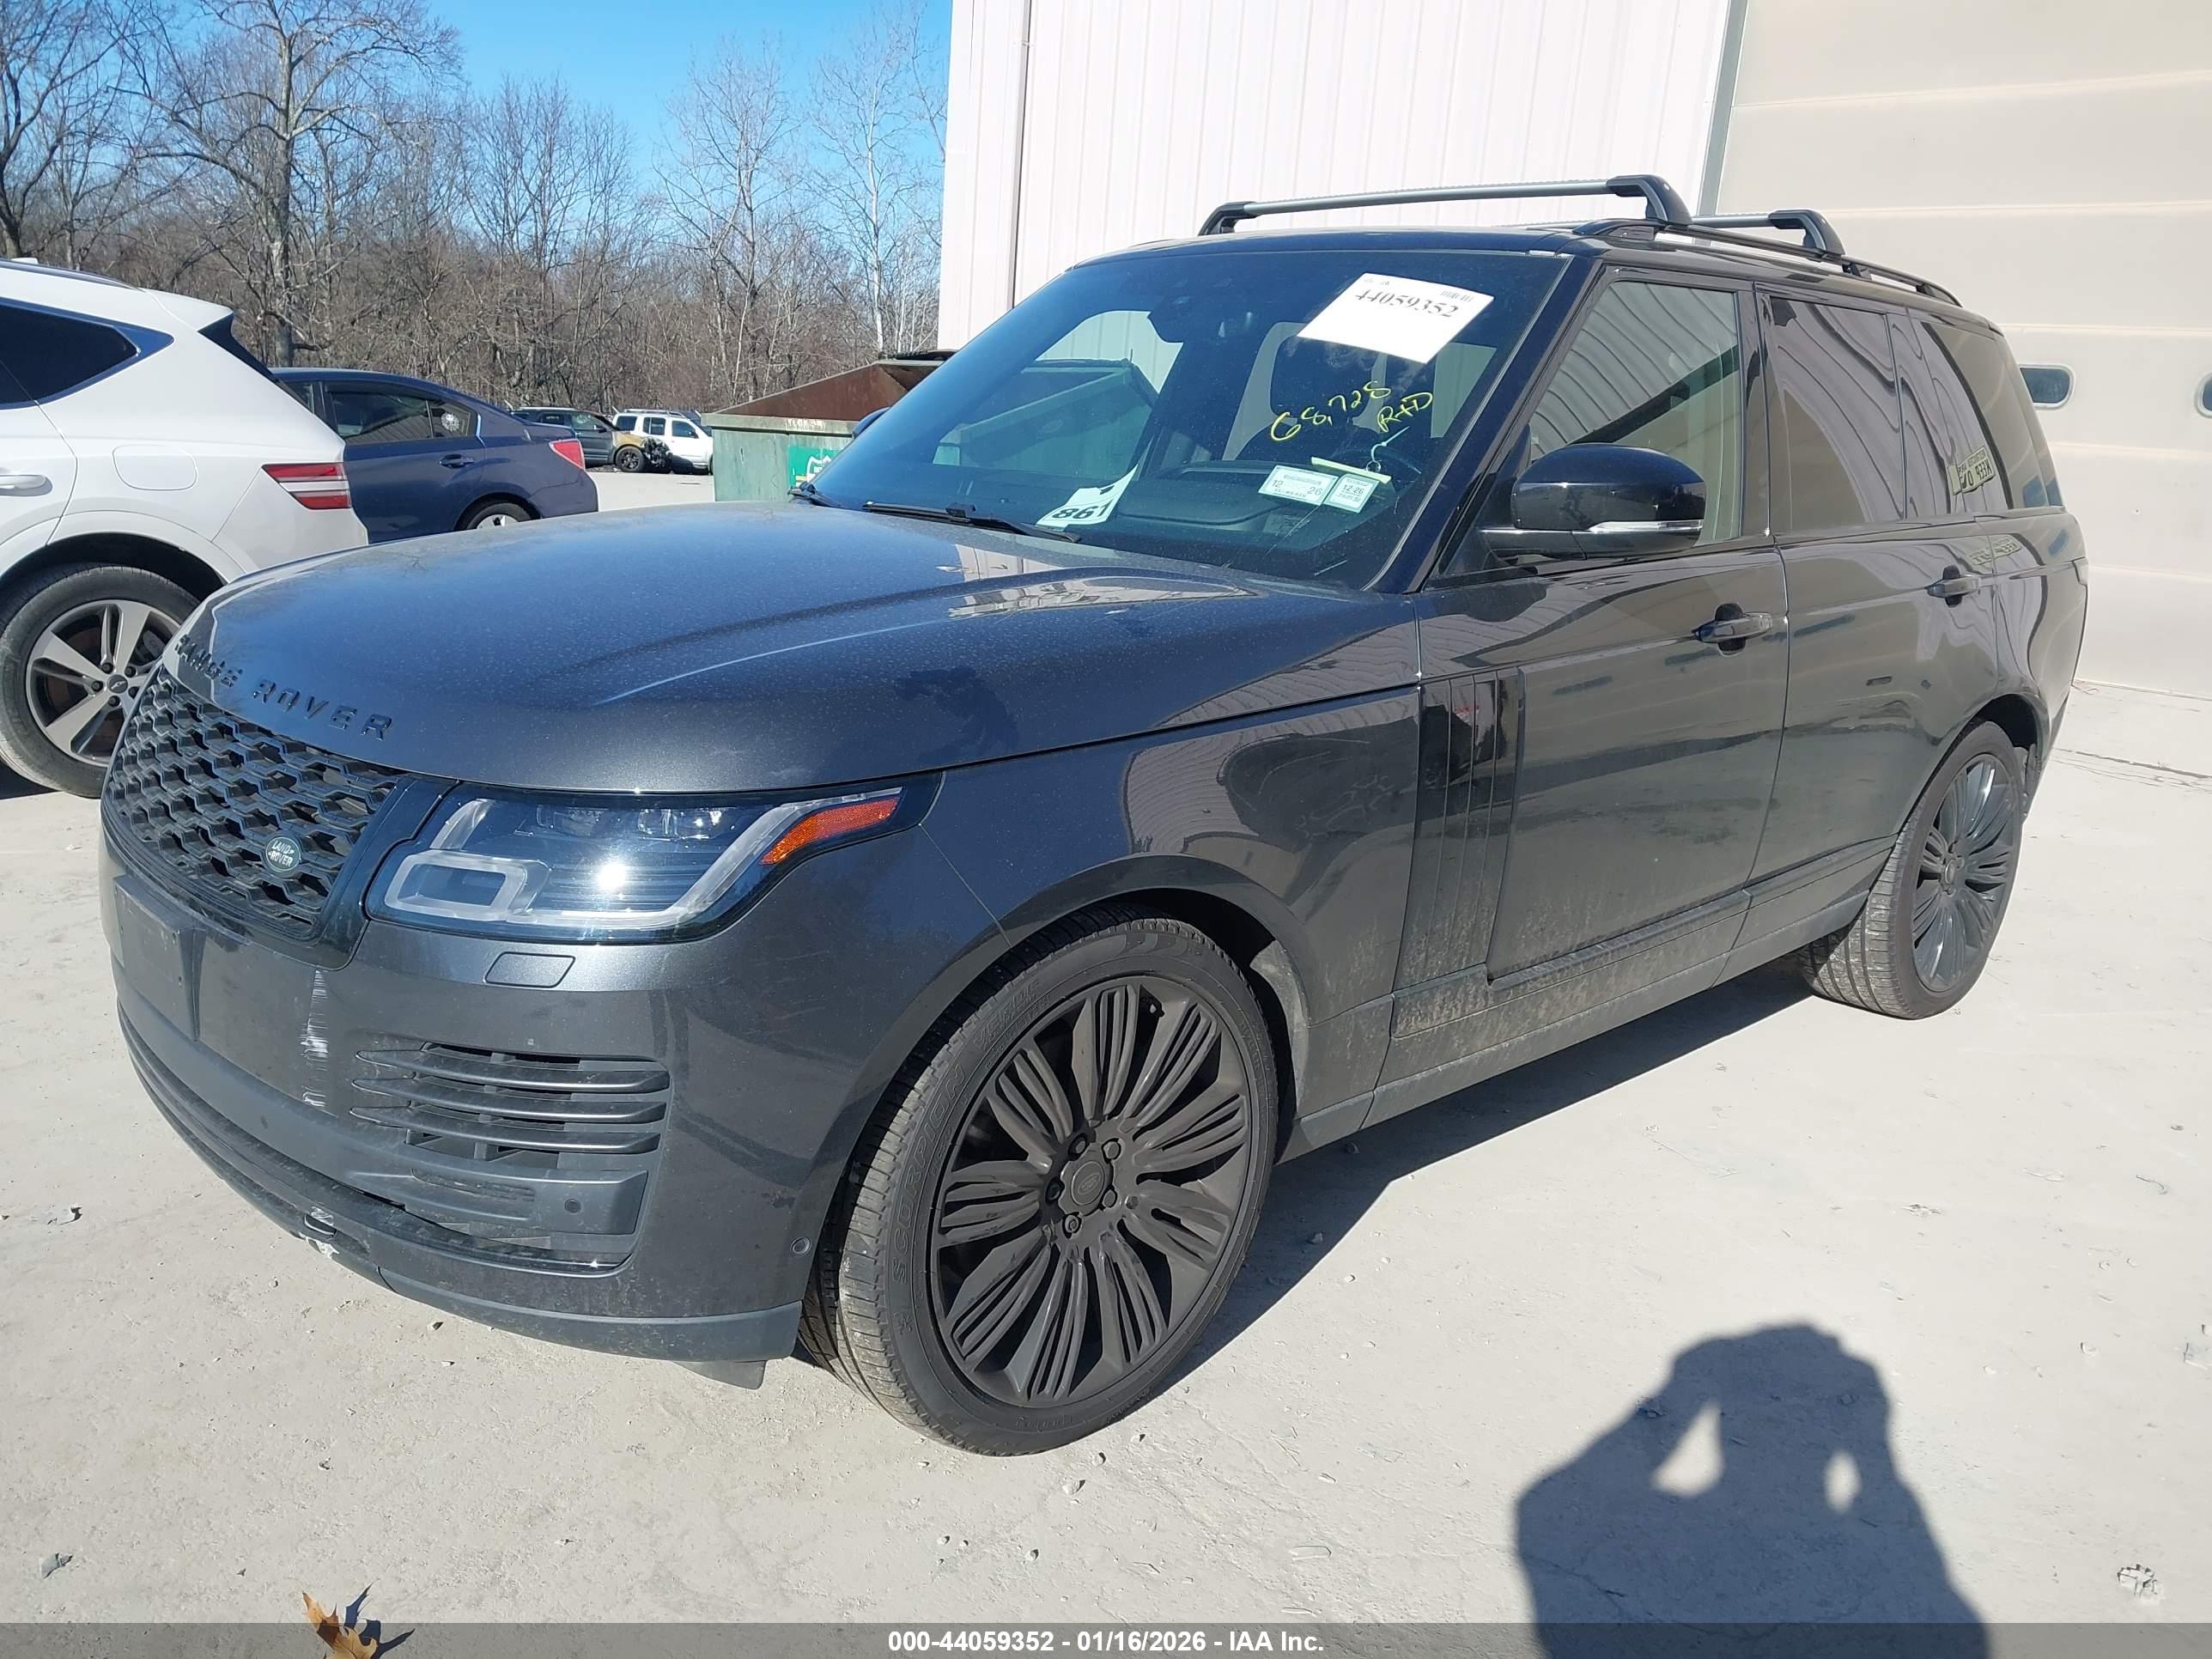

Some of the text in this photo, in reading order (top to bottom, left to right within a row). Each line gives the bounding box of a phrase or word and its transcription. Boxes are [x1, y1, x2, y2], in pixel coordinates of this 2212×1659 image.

[1355, 289, 1459, 318] 44059352
[252, 679, 392, 742] ROVER
[270, 850, 294, 867] ROVER
[271, 840, 292, 855] LAND
